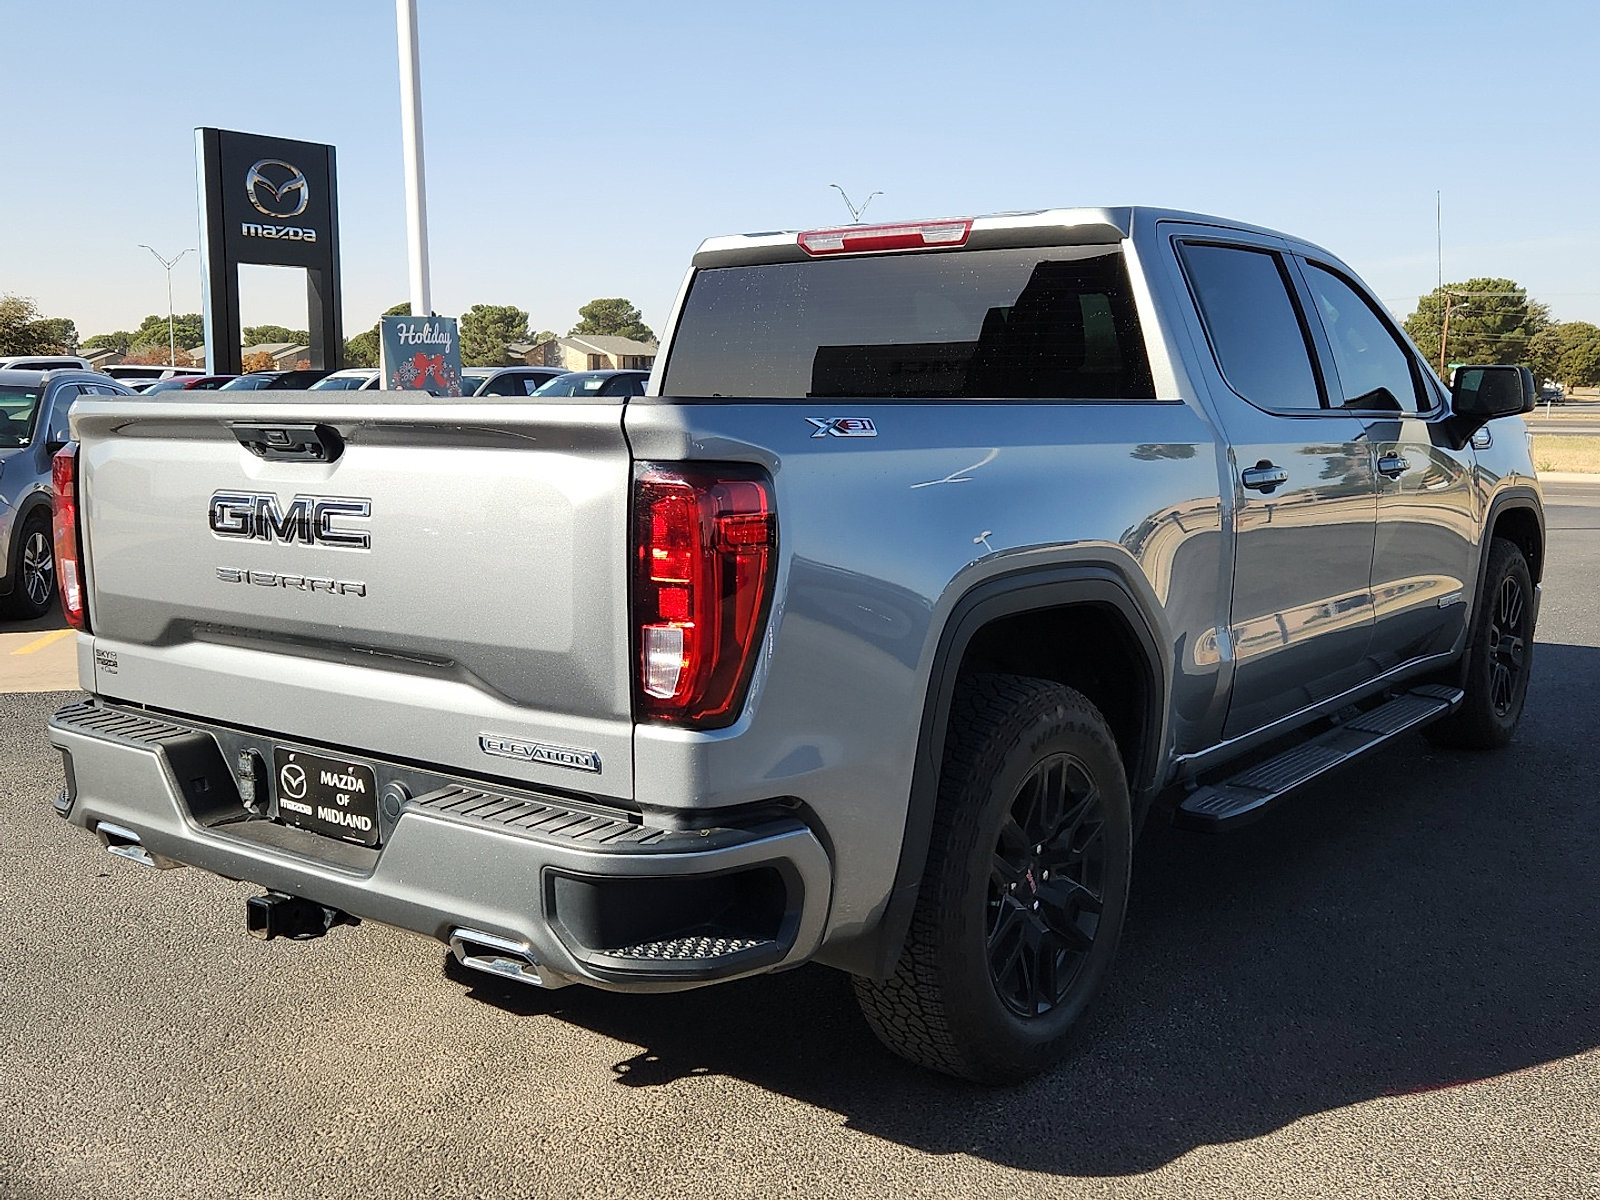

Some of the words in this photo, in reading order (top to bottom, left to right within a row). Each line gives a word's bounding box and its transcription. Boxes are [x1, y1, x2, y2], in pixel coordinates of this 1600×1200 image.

[241, 222, 317, 243] mazda
[396, 322, 452, 354] Holiday
[804, 416, 878, 437] X31
[208, 490, 372, 550] GMC
[215, 566, 367, 598] SIERRA
[484, 739, 591, 767] ELEVATION
[320, 770, 366, 794] MAZDA
[336, 793, 351, 807] OF
[317, 805, 372, 832] MIDLAND
